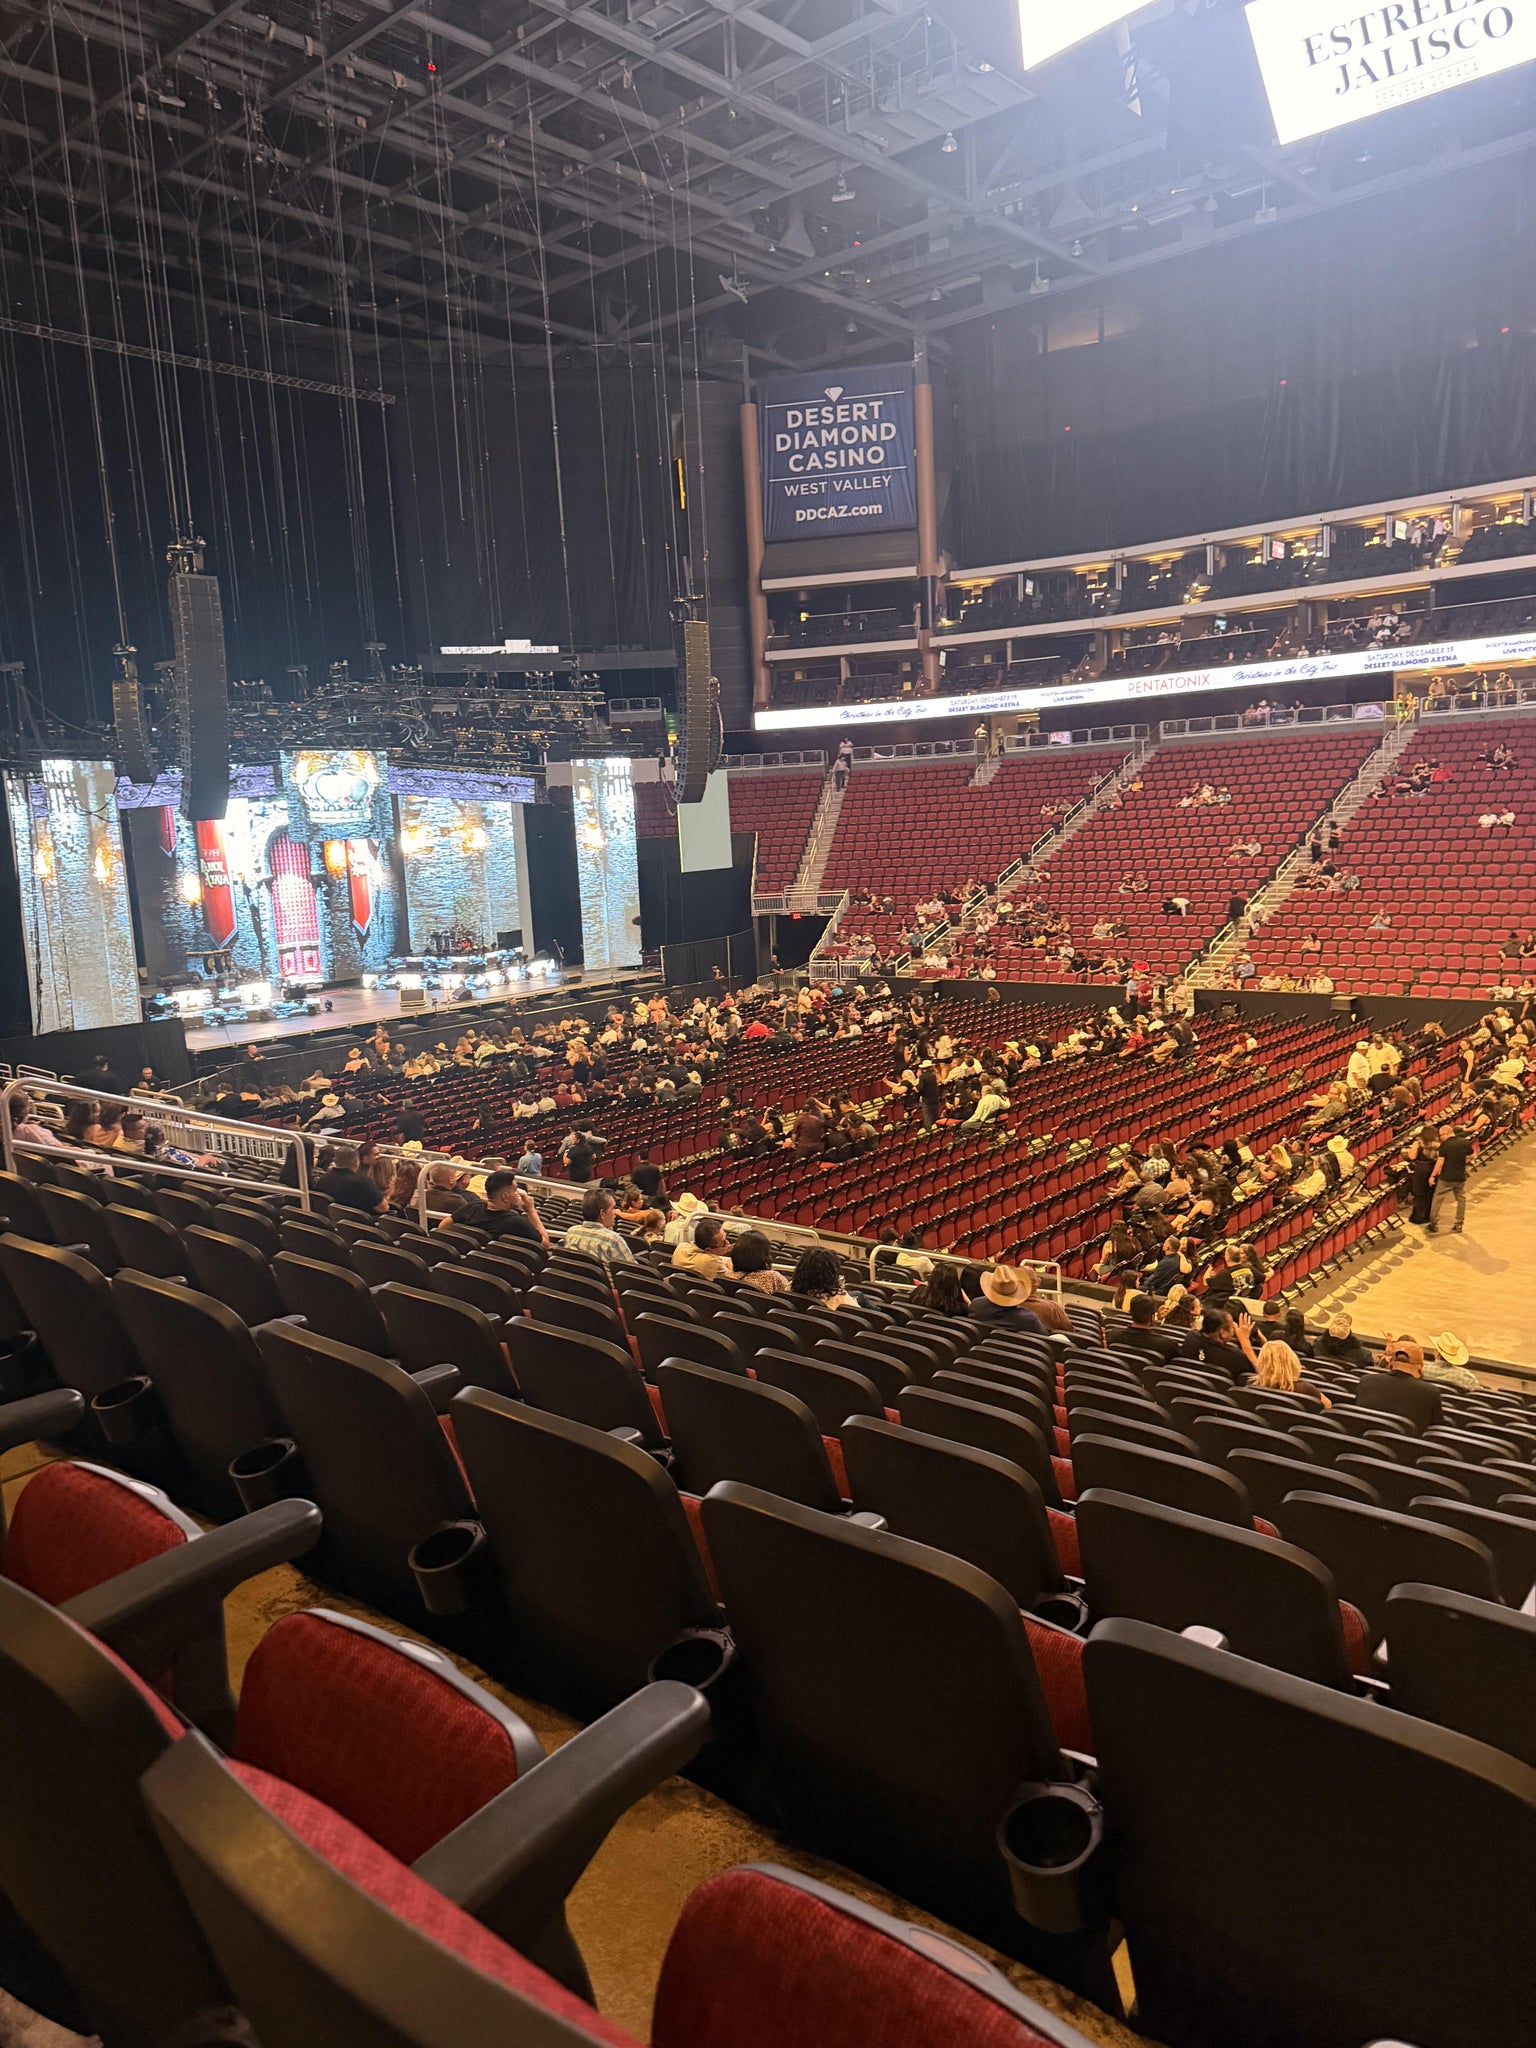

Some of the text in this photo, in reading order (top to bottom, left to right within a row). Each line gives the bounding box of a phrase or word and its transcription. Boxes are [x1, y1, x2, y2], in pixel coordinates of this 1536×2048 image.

[1302, 0, 1486, 67] ESTREL
[1335, 6, 1513, 95] JALISCO
[786, 400, 884, 429] DESERT
[775, 422, 897, 452] DIAMOND
[788, 445, 885, 473] CASINO
[784, 475, 892, 497] WEST VALLEY
[795, 503, 883, 522] DDCAZ.com
[1364, 654, 1458, 670] DESERT DIAMOND ARENA
[1405, 647, 1444, 657] DECEMBER
[1232, 670, 1272, 681] Christmas
[1273, 668, 1282, 676] in
[1284, 666, 1297, 675] the
[1299, 663, 1318, 677] City
[1128, 673, 1210, 693] PENTATONIX
[969, 703, 999, 711] DIAMOND
